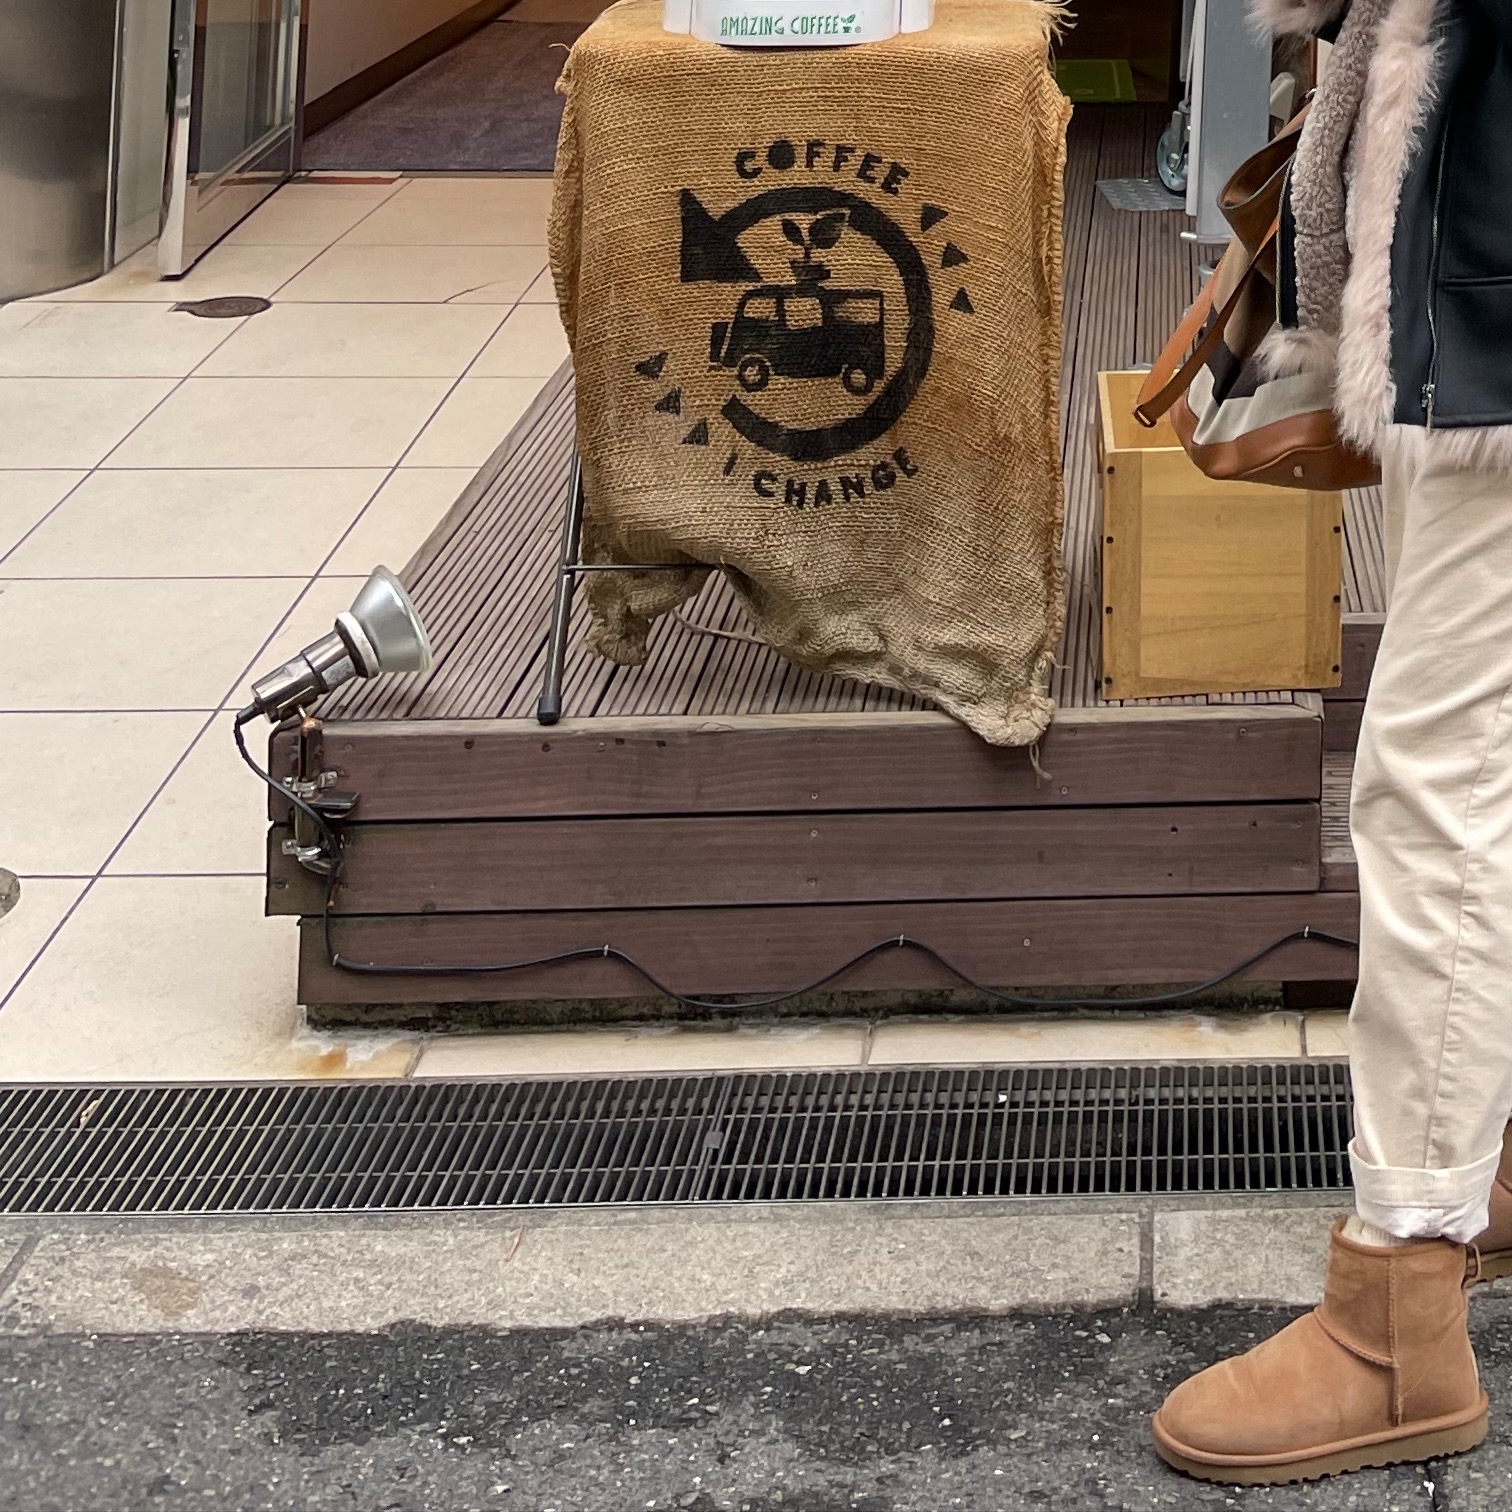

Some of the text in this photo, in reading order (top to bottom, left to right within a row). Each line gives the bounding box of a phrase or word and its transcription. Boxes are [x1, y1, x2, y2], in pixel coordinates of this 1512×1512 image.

[720, 14, 840, 37] AMAZING COFFEE
[734, 139, 911, 194] COFFEE
[752, 445, 920, 510] CHANGE
